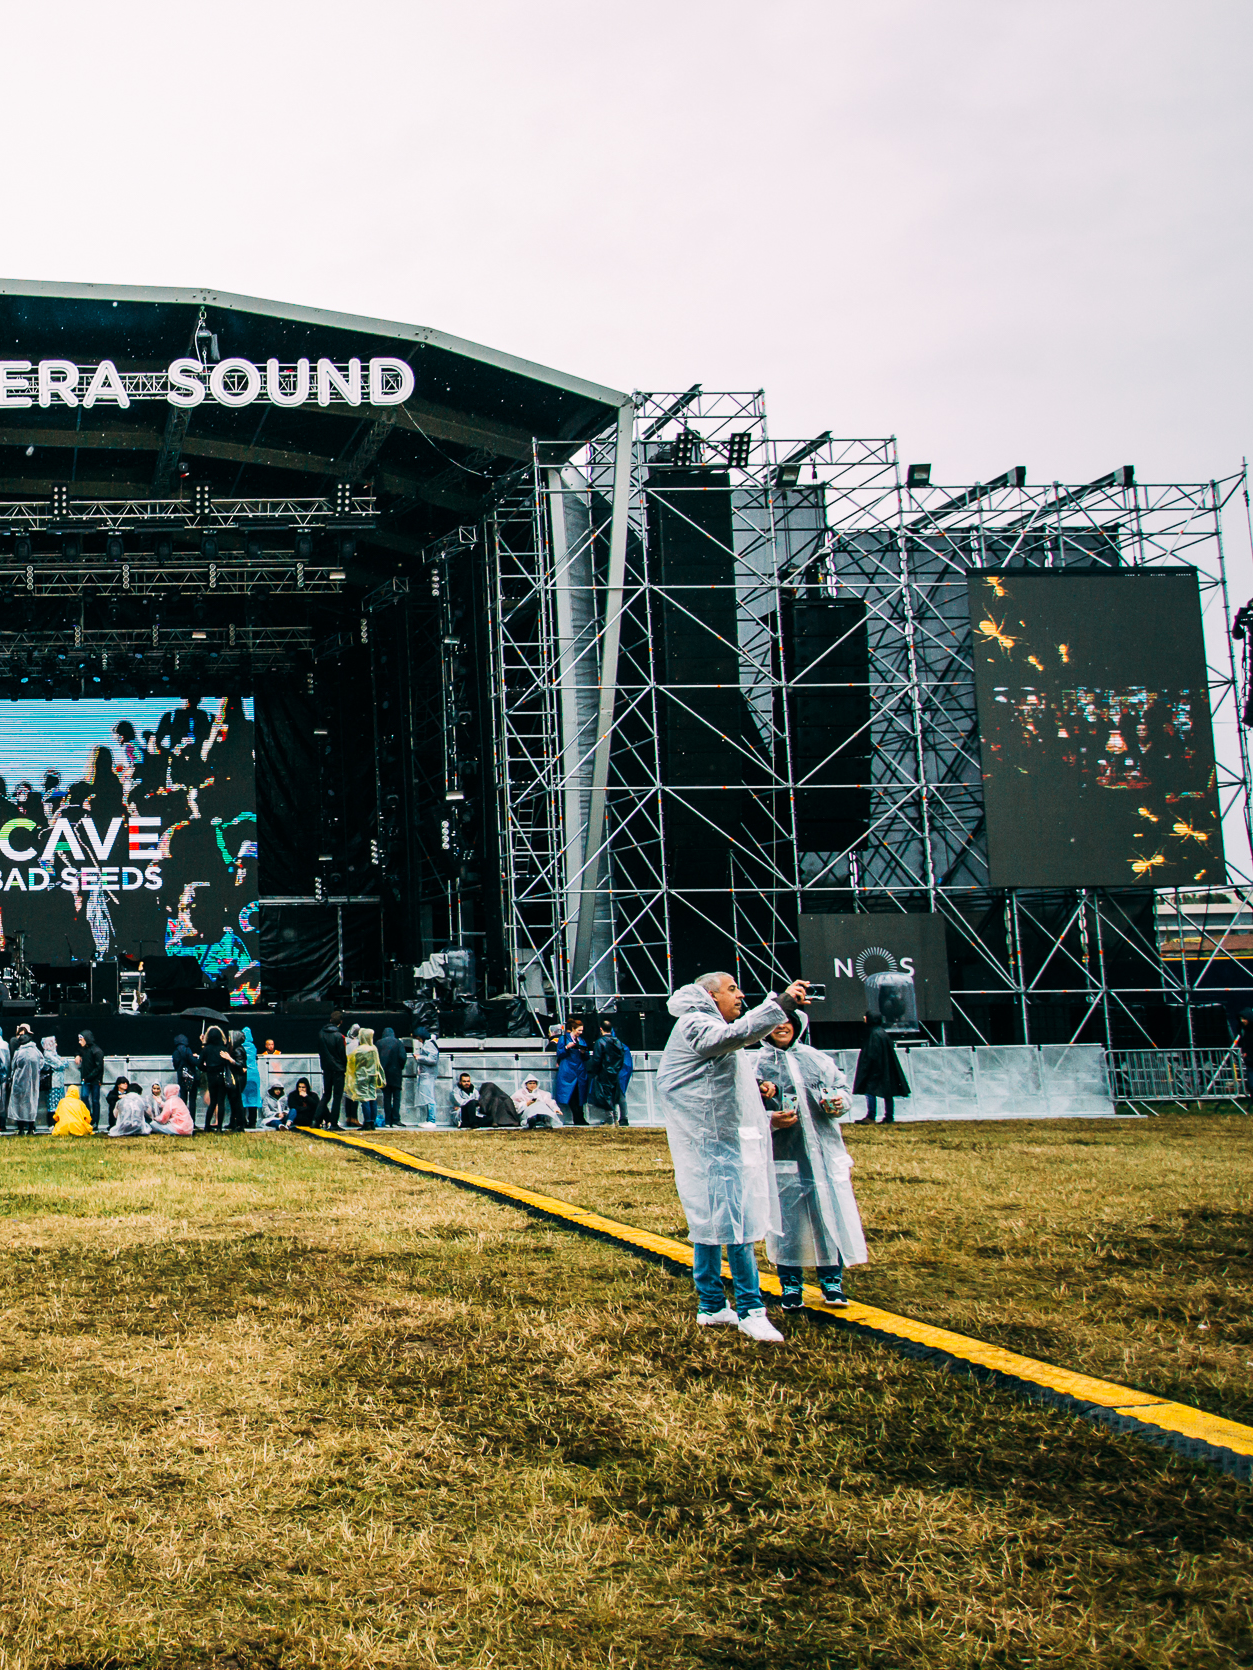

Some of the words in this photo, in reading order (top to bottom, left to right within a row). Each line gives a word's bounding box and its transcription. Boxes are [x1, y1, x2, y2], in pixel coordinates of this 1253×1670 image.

[167, 357, 415, 408] SOUND
[60, 867, 163, 891] SEEDS
[833, 946, 915, 985] NOS
